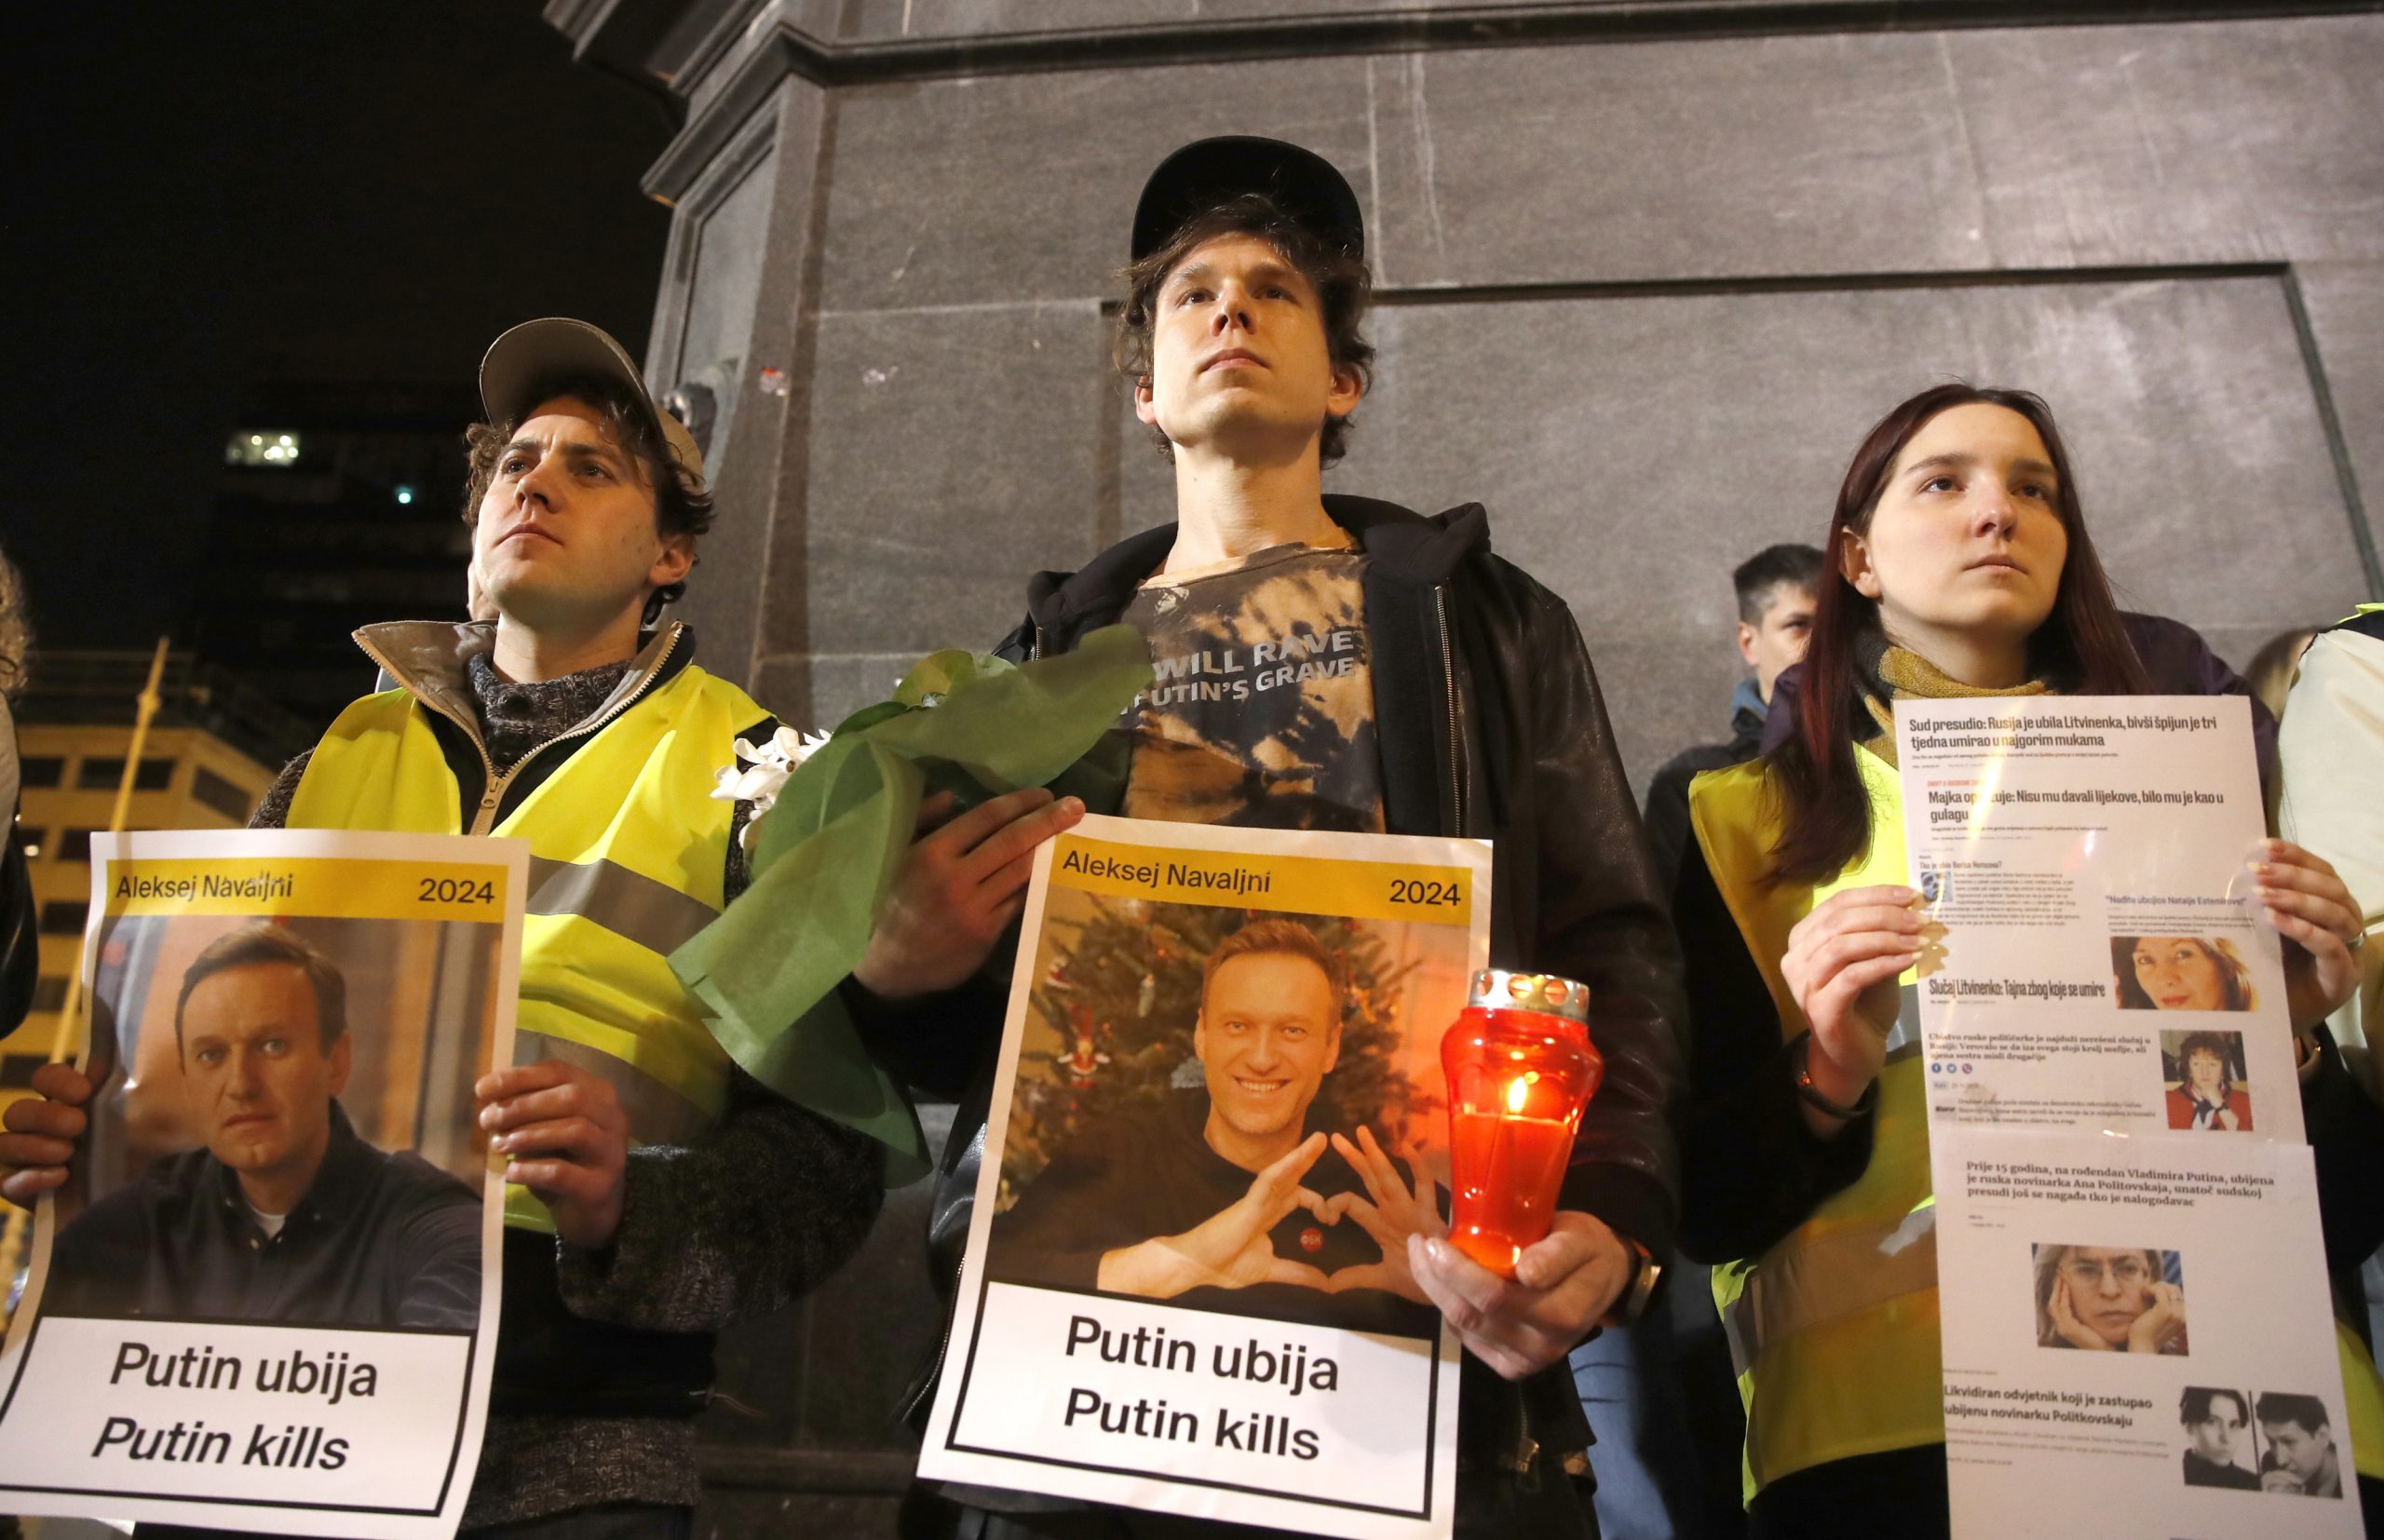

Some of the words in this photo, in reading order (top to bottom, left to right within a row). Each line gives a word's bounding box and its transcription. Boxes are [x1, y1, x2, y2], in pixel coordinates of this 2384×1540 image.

[1151, 648, 1244, 682] WILL
[1253, 629, 1355, 668] RAVE
[1255, 656, 1355, 692] GRAVE
[1909, 719, 1931, 732] Sud
[1932, 718, 1986, 733] presudio:
[1988, 716, 2022, 731] Rusija
[2023, 716, 2034, 731] je
[2036, 716, 2064, 729] ubila
[2064, 716, 2126, 730] Litvinenka,
[2127, 716, 2153, 729] bivši
[2155, 716, 2188, 731] špijun
[2189, 716, 2201, 732] je
[2202, 716, 2217, 729] tri
[1911, 736, 1947, 751] tjedna
[1949, 735, 1991, 748] umirao
[1993, 736, 1999, 747] u
[2001, 734, 2053, 750] najgorim
[2055, 733, 2106, 746] mukama
[1929, 791, 1962, 805] Majka
[2016, 790, 2040, 803] Nisu
[2043, 792, 2060, 803] mu
[2062, 790, 2094, 803] davali
[2095, 790, 2141, 805] lijekove,
[2142, 790, 2162, 804] bilo
[2164, 792, 2182, 804] mu
[2183, 791, 2193, 806] je
[2195, 791, 2215, 804] kao
[2216, 793, 2224, 804] u
[1930, 807, 1969, 823] gulagu
[116, 873, 196, 902] Aleksej
[417, 878, 495, 904] 2024
[1063, 849, 1159, 887] Aleksej
[1167, 863, 1271, 896] Navaljni
[1388, 879, 1461, 907] 2024
[1930, 979, 1956, 997] Slučaj
[1957, 979, 2003, 995] Litvinenko:
[2004, 979, 2027, 999] Tajna
[2028, 979, 2049, 1000] zbog
[2049, 980, 2066, 1000] koje
[2067, 984, 2079, 997] se
[2079, 981, 2106, 997] umire
[1967, 1161, 1994, 1173] Prije
[1996, 1164, 2007, 1173] 15
[2010, 1164, 2052, 1176] godina,
[2054, 1166, 2069, 1175] na
[2071, 1166, 2125, 1178] rođendan
[2128, 1169, 2184, 1181] Vladimira
[2187, 1172, 2228, 1184] Putina,
[2230, 1174, 2274, 1186] ubijena
[1967, 1174, 1977, 1185] je
[1979, 1174, 2011, 1184] ruska
[2013, 1176, 2071, 1188] novinarka
[2073, 1179, 2095, 1188] Ana
[2174, 1184, 2214, 1196] unatoč
[2215, 1186, 2262, 1199] sudskoj
[1968, 1187, 2010, 1198] presudi
[2012, 1188, 2029, 1199] još
[2046, 1191, 2086, 1202] nagađa
[2089, 1192, 2108, 1202] tko
[2110, 1193, 2120, 1204] je
[2123, 1195, 2195, 1208] nalogodavac
[1064, 1315, 1197, 1372] Putin
[1212, 1339, 1339, 1396] ubija
[110, 1342, 242, 1391] Putin
[255, 1350, 378, 1405] ubija
[1944, 1385, 2001, 1398] Likvidiran
[2003, 1388, 2058, 1403] odvjetnik
[2061, 1391, 2082, 1407] koji
[2084, 1393, 2096, 1407] je
[2098, 1396, 2153, 1410] zastupao
[1063, 1387, 1199, 1443] Putin
[1215, 1408, 1321, 1461] kills
[1944, 1403, 1988, 1419] ubijenu
[1991, 1408, 2050, 1421] novinarku
[2052, 1410, 2133, 1428] Politkovskaju
[90, 1416, 232, 1465] Putin
[242, 1424, 351, 1471] kills
